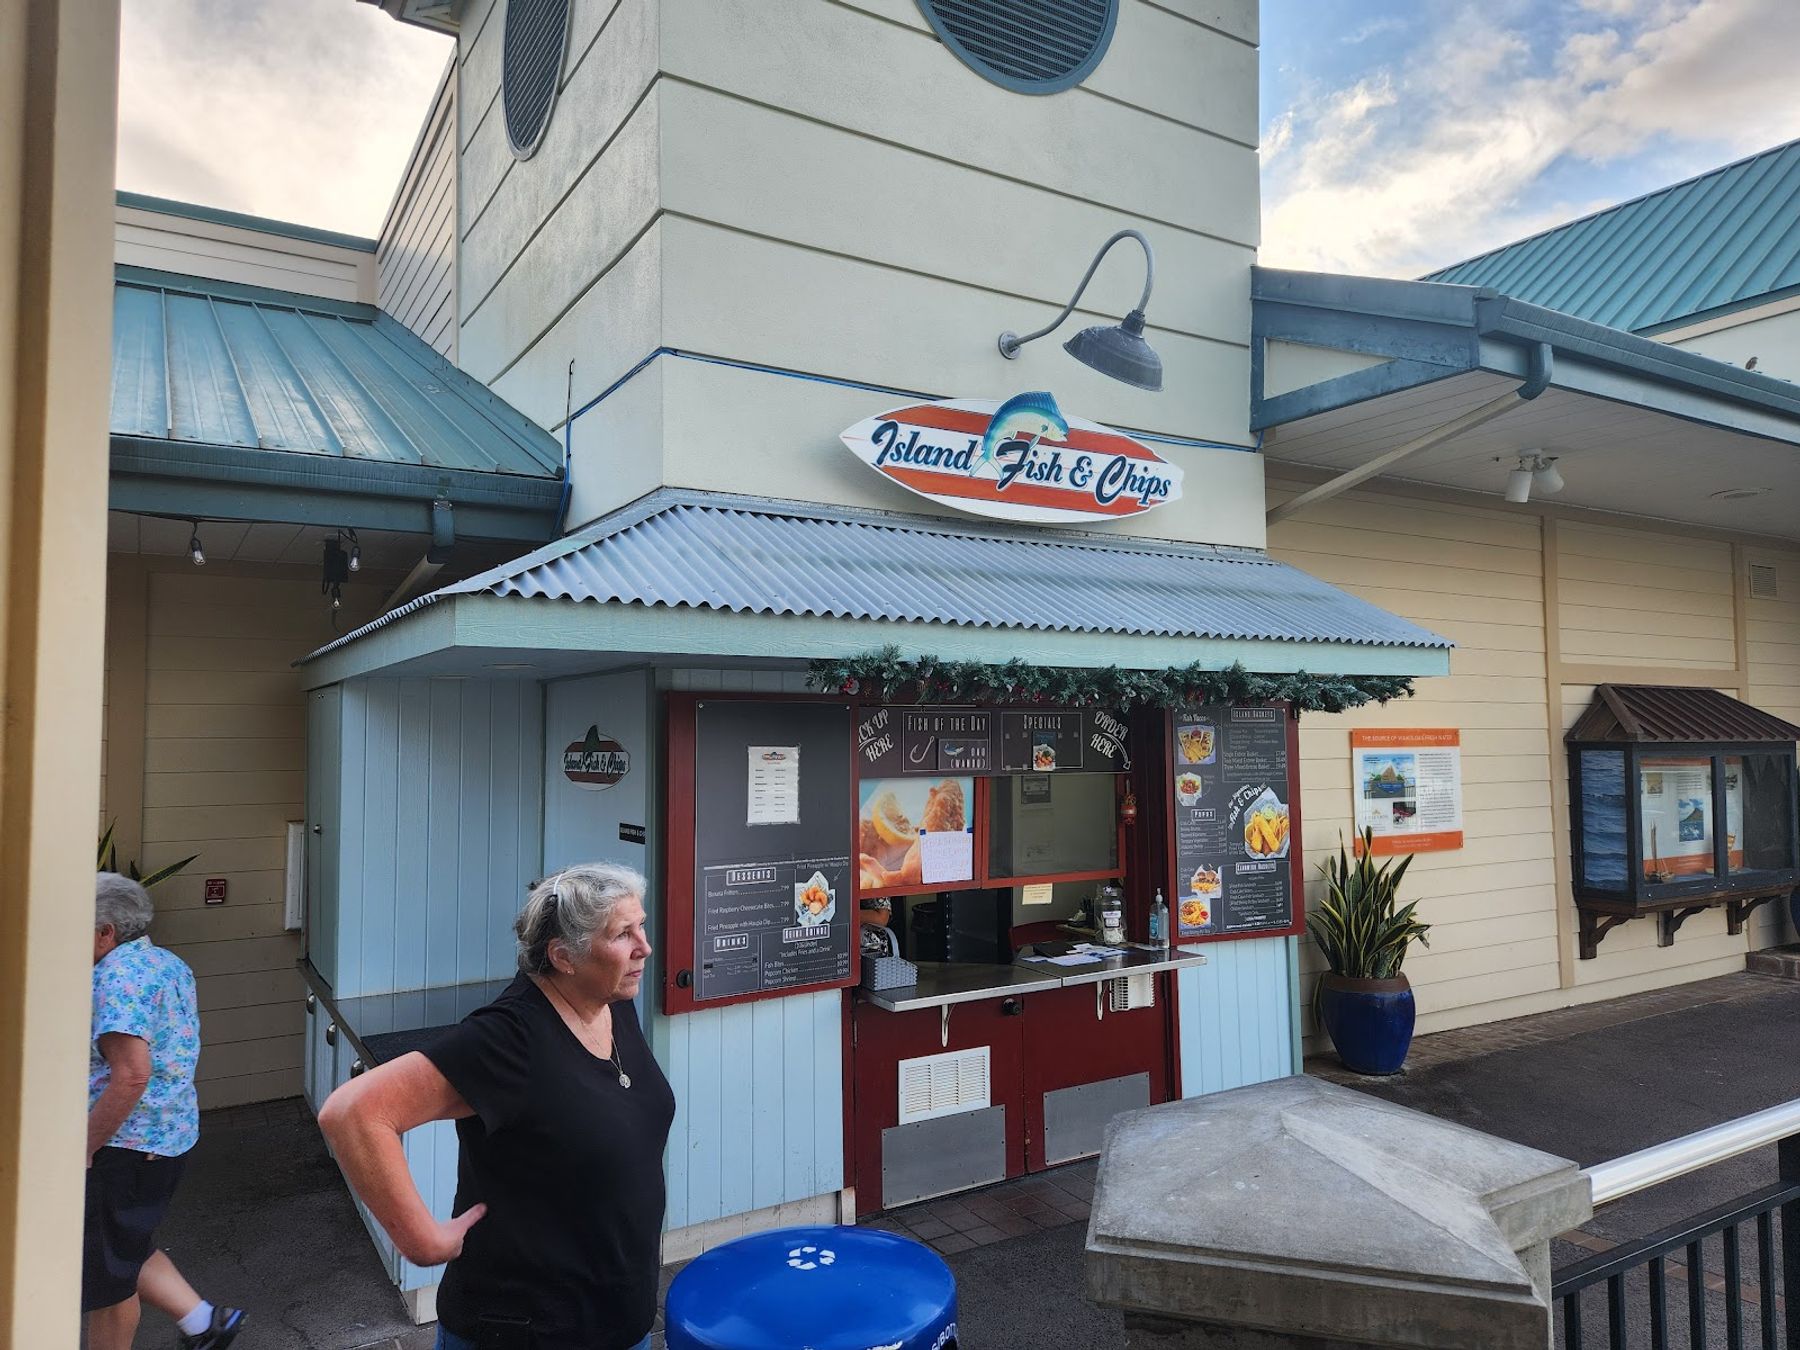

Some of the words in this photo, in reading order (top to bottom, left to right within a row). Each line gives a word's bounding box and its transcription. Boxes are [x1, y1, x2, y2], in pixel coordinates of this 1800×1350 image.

[871, 420, 977, 474] Island
[995, 438, 1066, 491] Fish
[1068, 455, 1093, 488] &
[1095, 454, 1172, 507] Chips
[872, 708, 889, 729] UP
[908, 715, 929, 731] FISH
[935, 717, 944, 731] OF
[950, 717, 966, 731] THE
[971, 715, 986, 731] DAY
[1023, 714, 1061, 730] SPECIALS
[1094, 711, 1129, 741] ORDER
[865, 733, 894, 762] HERE
[1090, 733, 1118, 759] HERE
[1243, 786, 1263, 800] Chips
[732, 869, 772, 882] DESSERTS
[708, 924, 719, 932] Fried
[716, 936, 746, 949] DRINKS
[764, 961, 774, 969] Fish
[782, 967, 799, 976] Chicken
